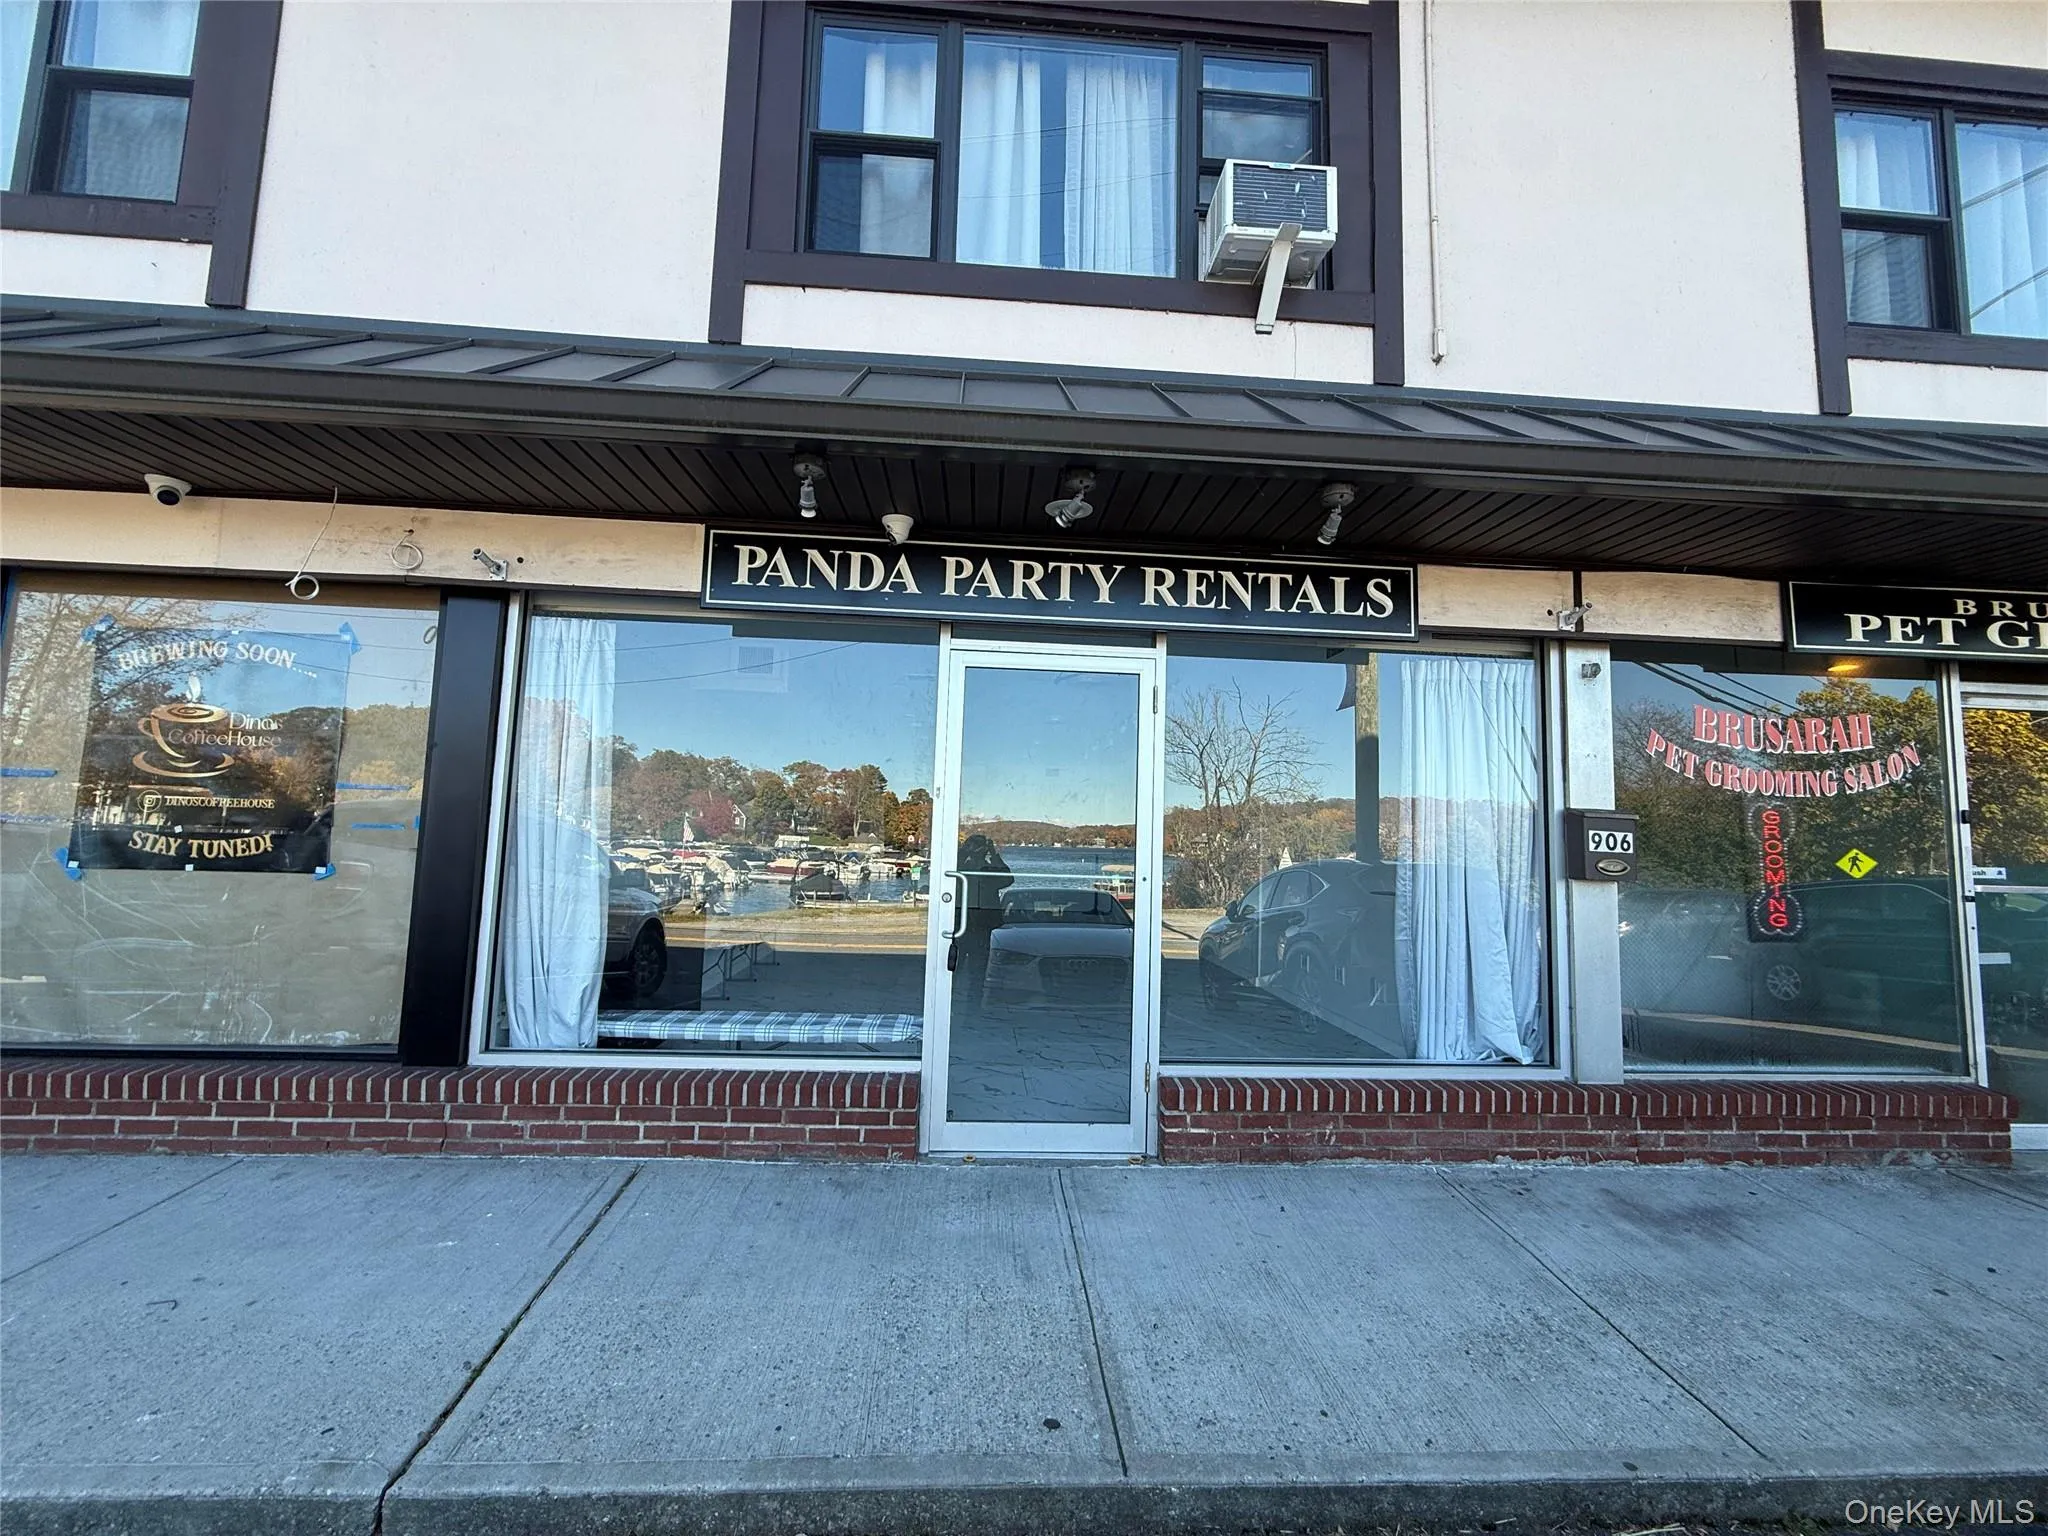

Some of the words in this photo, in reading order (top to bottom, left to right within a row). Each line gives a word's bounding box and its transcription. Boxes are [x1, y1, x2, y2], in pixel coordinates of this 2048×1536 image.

[733, 545, 922, 594] PANDA
[941, 555, 1127, 604] PARTY
[1140, 565, 1394, 620] RENTALS
[1844, 613, 1967, 646] PET
[119, 641, 227, 669] BREWING
[168, 729, 282, 747] CoffeeHouse
[1692, 704, 1875, 755] BRUSARAH
[1645, 728, 1699, 780] PET
[1704, 759, 1838, 798] GROOMING
[1842, 741, 1921, 795] SALON
[128, 831, 183, 857] STAY
[187, 834, 274, 858] TUNED!
[1591, 832, 1631, 852] 906
[1761, 810, 1789, 927] GROOMING
